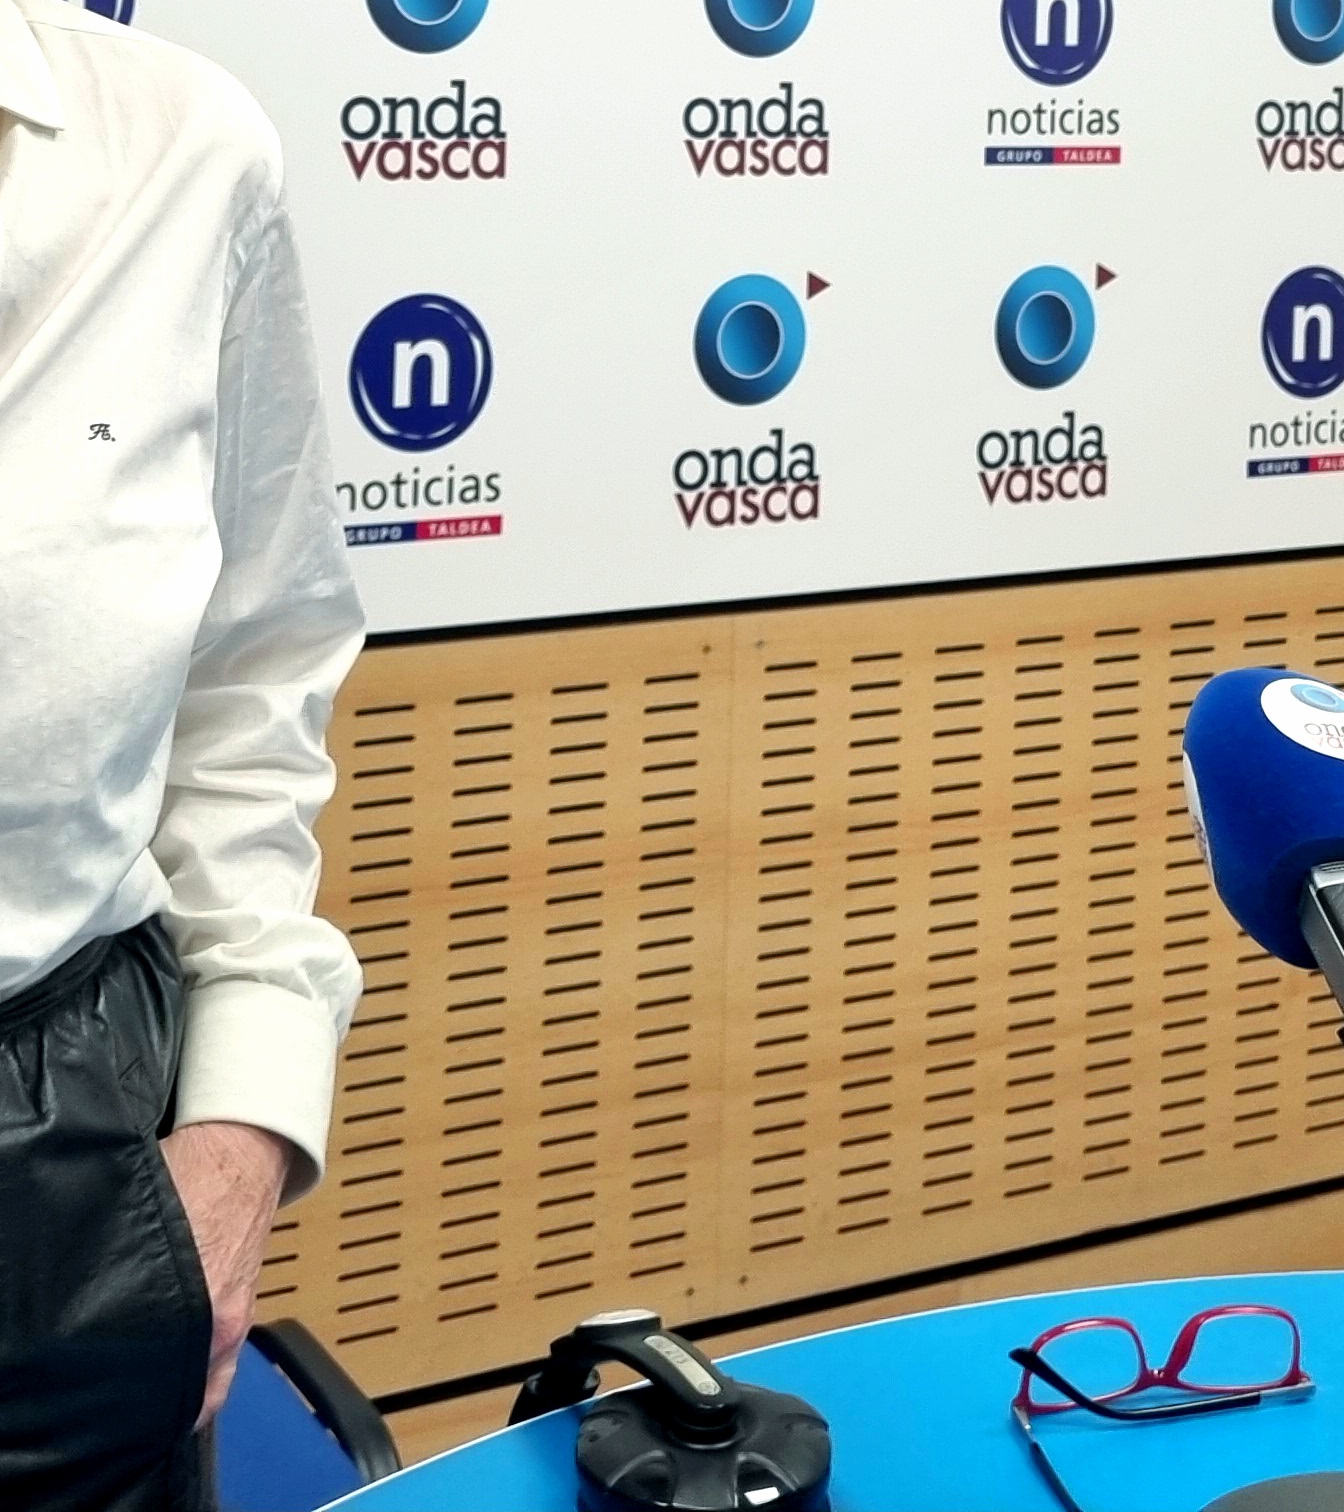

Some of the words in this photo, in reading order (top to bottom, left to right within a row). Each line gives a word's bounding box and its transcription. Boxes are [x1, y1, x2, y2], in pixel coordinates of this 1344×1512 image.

[340, 80, 506, 140] onda
[683, 83, 829, 138] onda
[986, 98, 1120, 137] noticias
[342, 137, 506, 181] vasca
[685, 136, 829, 177] vasca
[996, 150, 1043, 162] GRUPO
[1062, 150, 1112, 162] TALDEA
[1293, 301, 1332, 363] n
[391, 337, 450, 408] n
[674, 429, 819, 491] onda
[977, 412, 1107, 469] onda
[336, 463, 501, 511] noticias
[674, 482, 820, 529] vasca
[978, 460, 1107, 505] vasca
[428, 519, 492, 537] TALDEA
